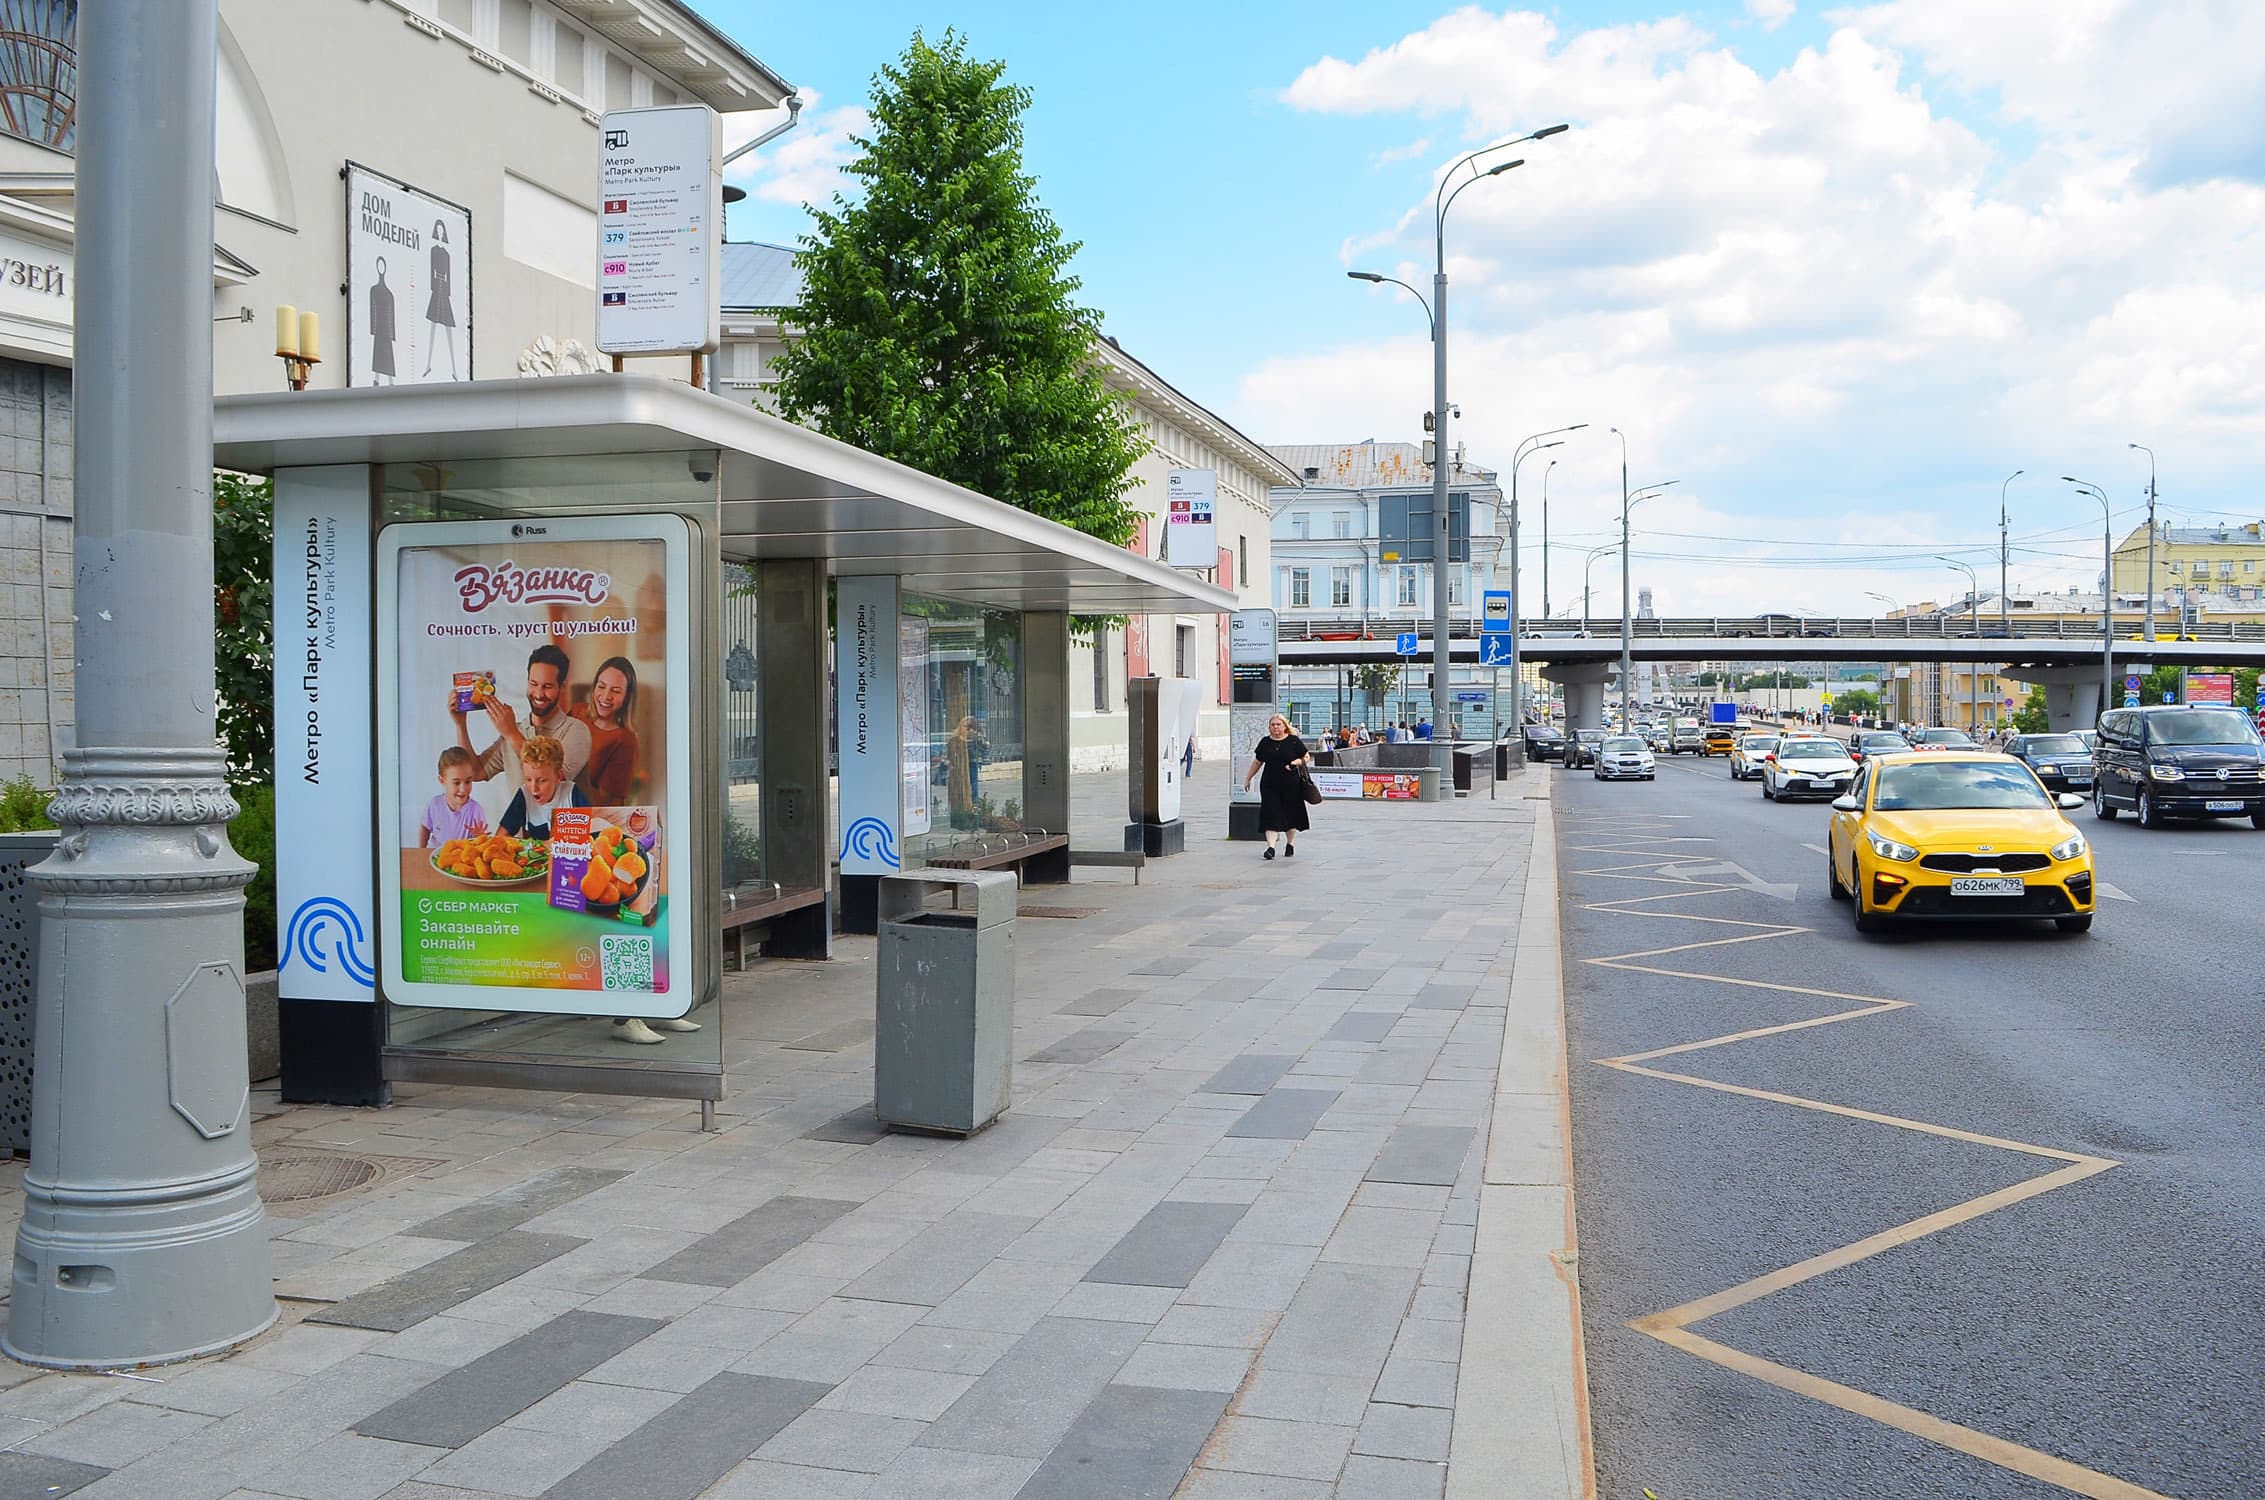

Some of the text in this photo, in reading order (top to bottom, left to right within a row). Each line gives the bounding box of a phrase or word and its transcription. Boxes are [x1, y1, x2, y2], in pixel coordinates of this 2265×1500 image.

[604, 158, 635, 167] Метро
[604, 164, 681, 177] «Парк культуры»
[361, 191, 391, 219] ДОМ
[362, 213, 420, 251] МОДЕЛЕЙ
[606, 233, 624, 243] 379
[1194, 502, 1210, 510] 379
[526, 526, 547, 535] Russ
[324, 516, 337, 650] Metro Park Kultury
[869, 604, 877, 633] Kultury
[426, 618, 637, 638] Сочность, хруст и улыбки!
[304, 516, 322, 785] Метро «Парк культуры»
[856, 604, 868, 754] Метро «Парк культуры»
[558, 827, 587, 835] НАГГЕТСЫ
[1956, 879, 2020, 891] О626МК 799
[435, 901, 518, 914] СБЕР МАРКЕТ
[420, 918, 520, 936] Заказывайте
[420, 936, 476, 951] онлайн
[580, 952, 591, 962] 12+
